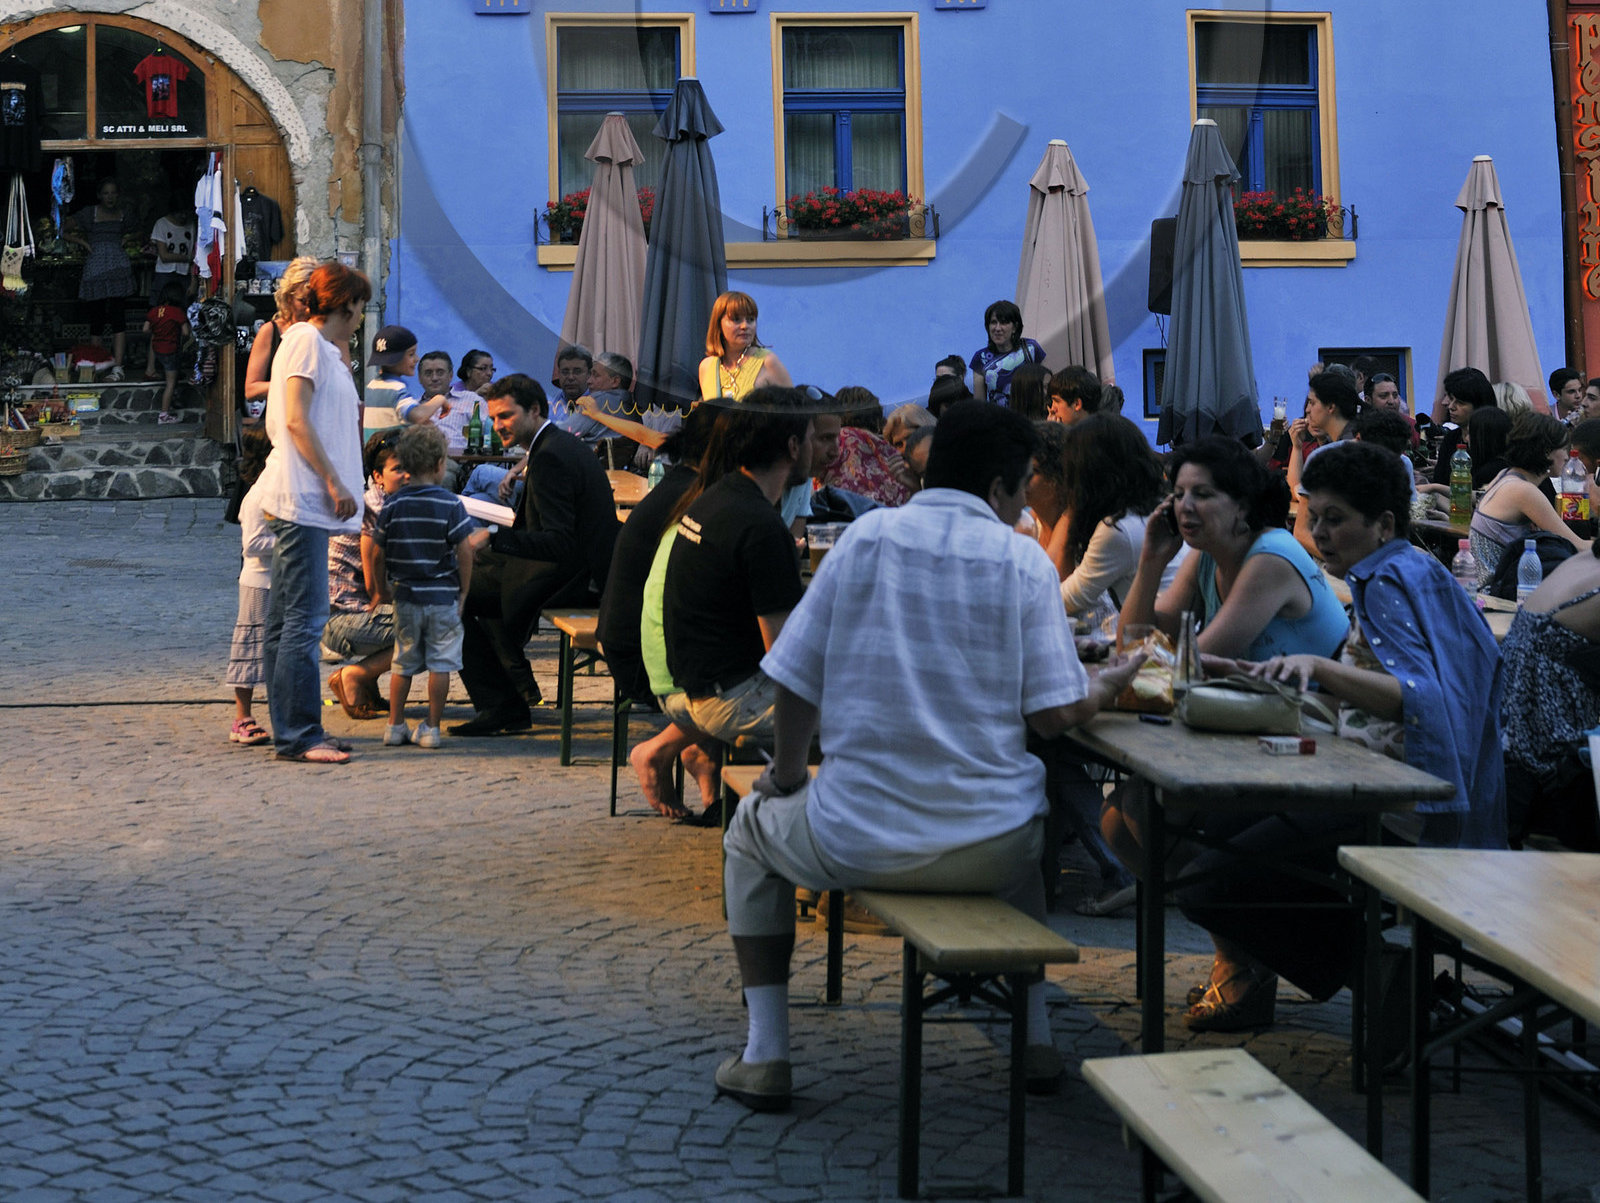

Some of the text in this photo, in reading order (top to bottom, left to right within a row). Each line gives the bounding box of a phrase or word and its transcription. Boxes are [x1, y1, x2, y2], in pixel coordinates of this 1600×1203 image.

[103, 124, 188, 133] SC ATTI & MELI SRL
